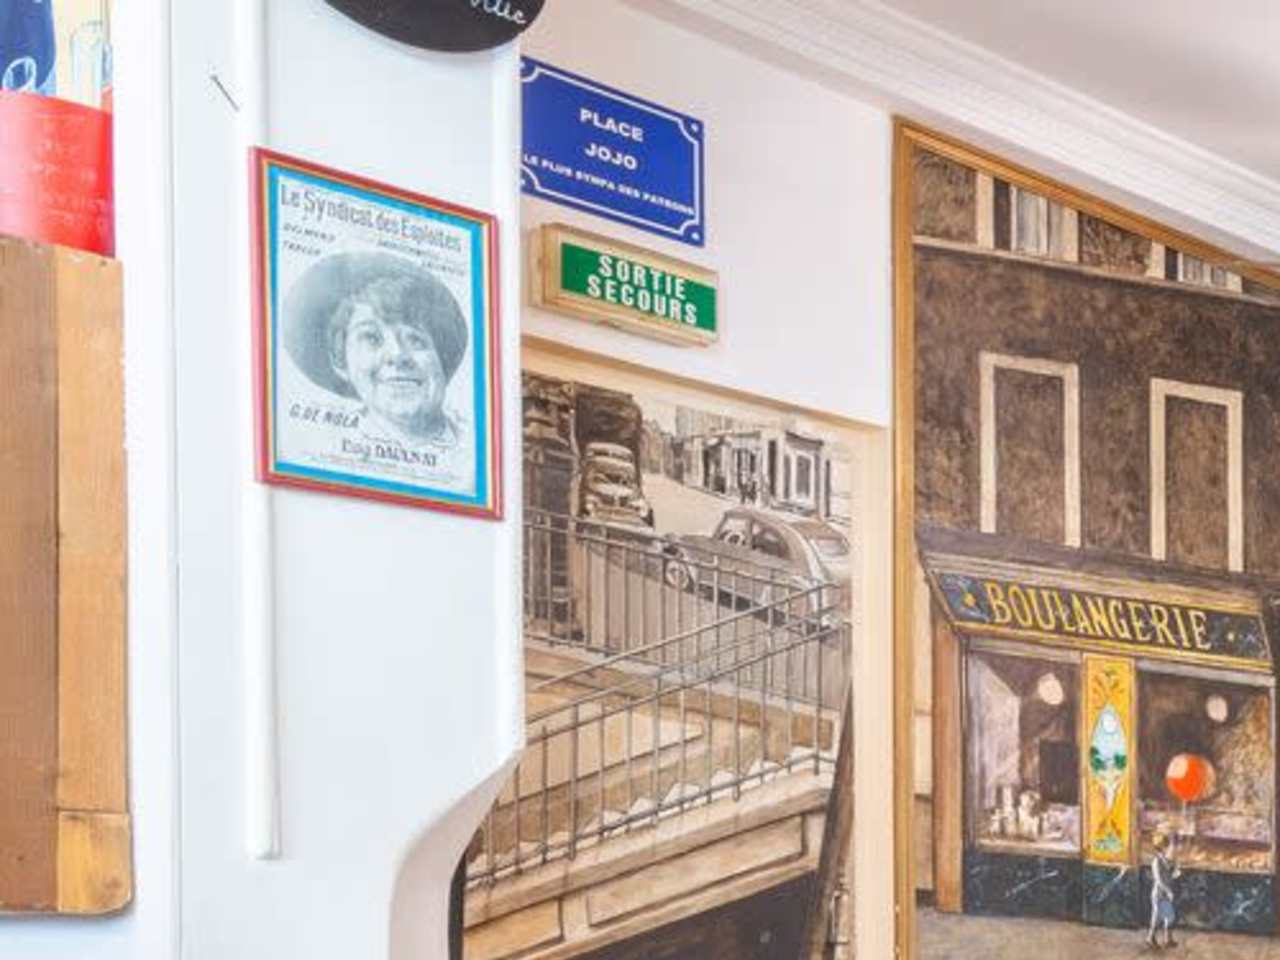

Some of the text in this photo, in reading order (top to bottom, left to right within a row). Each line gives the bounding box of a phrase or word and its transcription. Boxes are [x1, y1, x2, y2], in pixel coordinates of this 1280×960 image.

[579, 107, 643, 142] PLACE
[523, 153, 539, 167] LE
[541, 159, 574, 178] PLUS
[575, 170, 616, 191] SYMPA
[618, 181, 642, 199] DES
[584, 143, 638, 170] JOJO
[281, 183, 301, 208] Le
[303, 189, 374, 228] Syndicat
[375, 208, 399, 235] des
[587, 274, 698, 325] SECOURS
[598, 255, 686, 300] SORTIE
[984, 581, 1212, 651] BOULANGERIE
